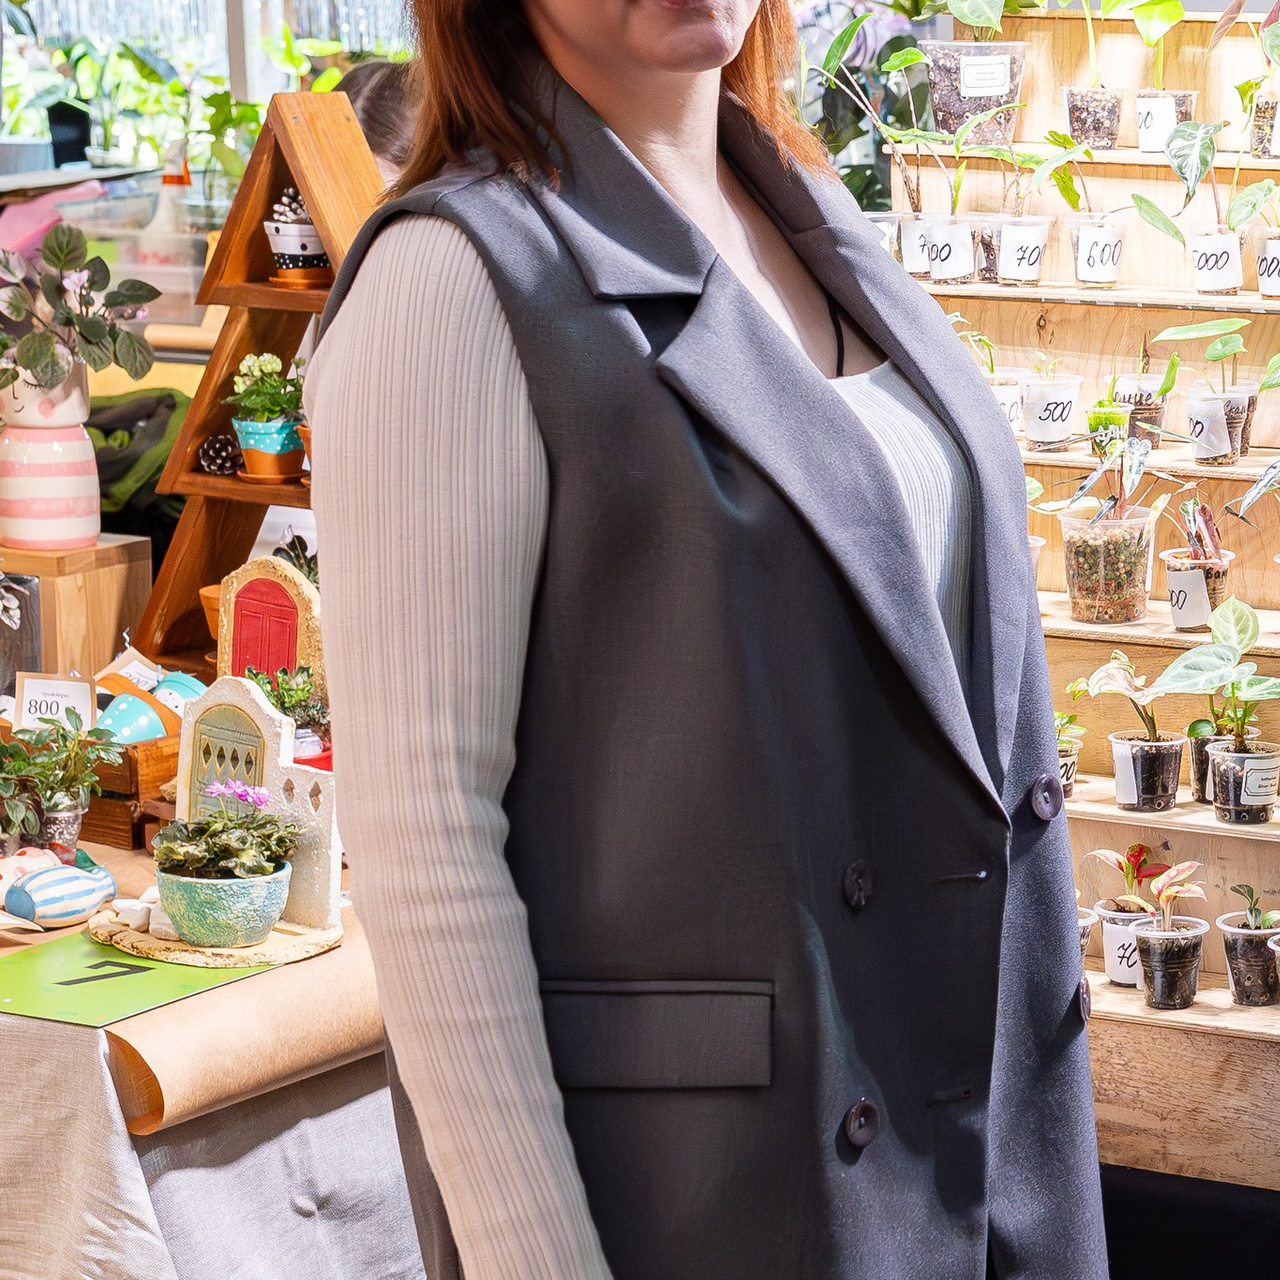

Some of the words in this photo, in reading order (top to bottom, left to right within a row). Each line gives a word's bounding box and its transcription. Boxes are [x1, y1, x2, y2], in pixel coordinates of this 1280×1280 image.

[1086, 239, 1123, 269] 600
[1038, 400, 1073, 423] 500
[28, 699, 60, 718] 800
